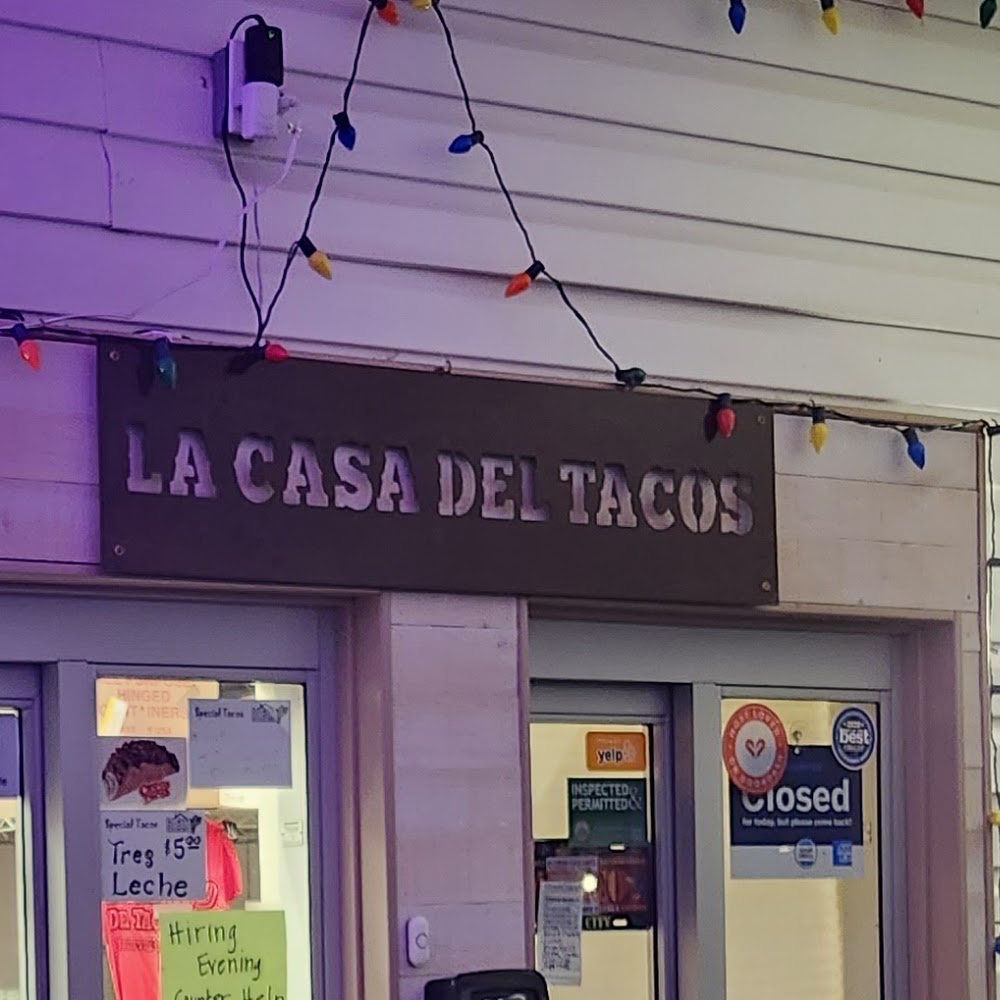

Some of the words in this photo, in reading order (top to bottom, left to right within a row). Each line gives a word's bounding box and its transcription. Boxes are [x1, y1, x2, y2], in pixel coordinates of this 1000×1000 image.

[126, 422, 216, 498] LA
[233, 432, 420, 513] CASA
[436, 450, 548, 521] DEL
[559, 459, 754, 536] TACOS
[597, 749, 623, 763] yelp
[571, 783, 629, 797] INSPECTED
[742, 778, 850, 813] Closed
[571, 798, 628, 811] PERMITTED
[112, 872, 188, 897] Leche
[169, 921, 237, 954] Hiring
[197, 950, 262, 981] Evening
